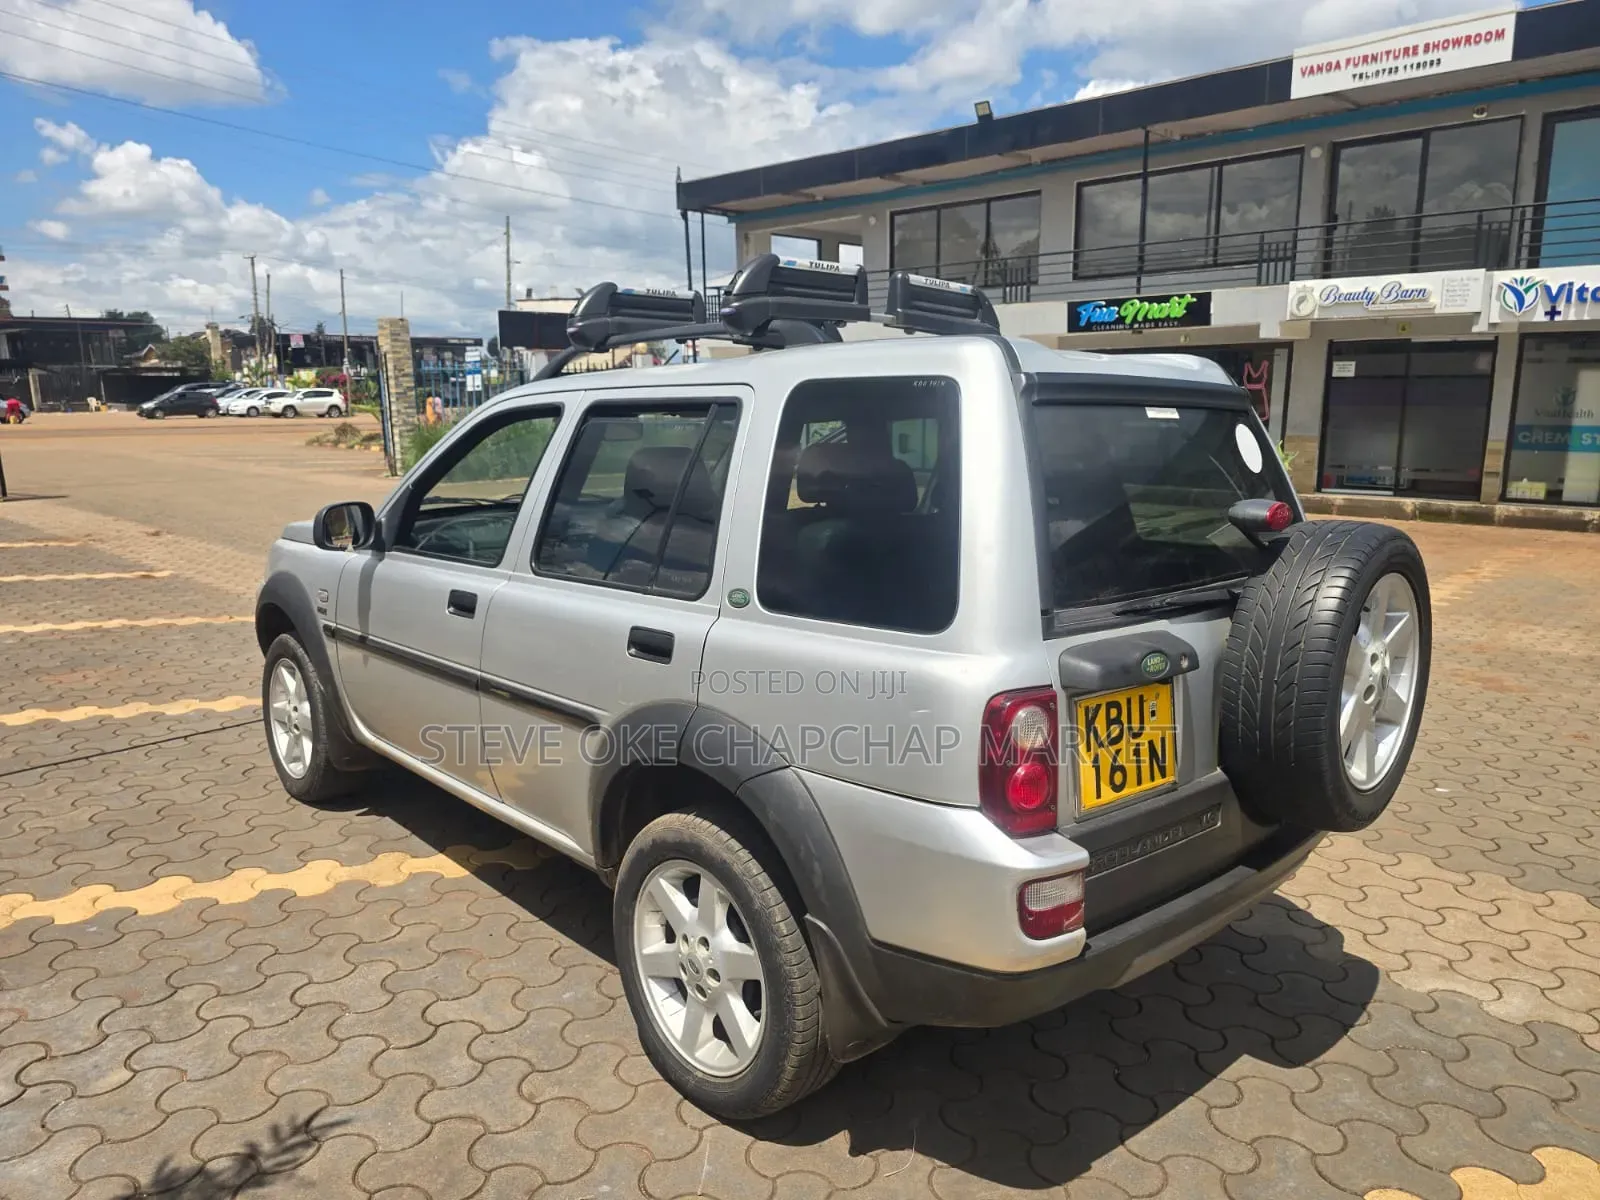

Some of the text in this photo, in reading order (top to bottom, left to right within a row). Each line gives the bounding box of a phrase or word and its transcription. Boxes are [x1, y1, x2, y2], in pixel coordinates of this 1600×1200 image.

[1300, 28, 1506, 78] VANGA FURNITURE SHOWROOM
[809, 261, 840, 273] TULIPA
[646, 288, 677, 297] TULIPA
[924, 278, 950, 289] TULIPA
[1320, 284, 1376, 307] Beauty
[1381, 281, 1427, 302] Barn
[1120, 294, 1197, 325] Mart
[1084, 695, 1144, 752] KBU
[1092, 737, 1167, 799] 161N
